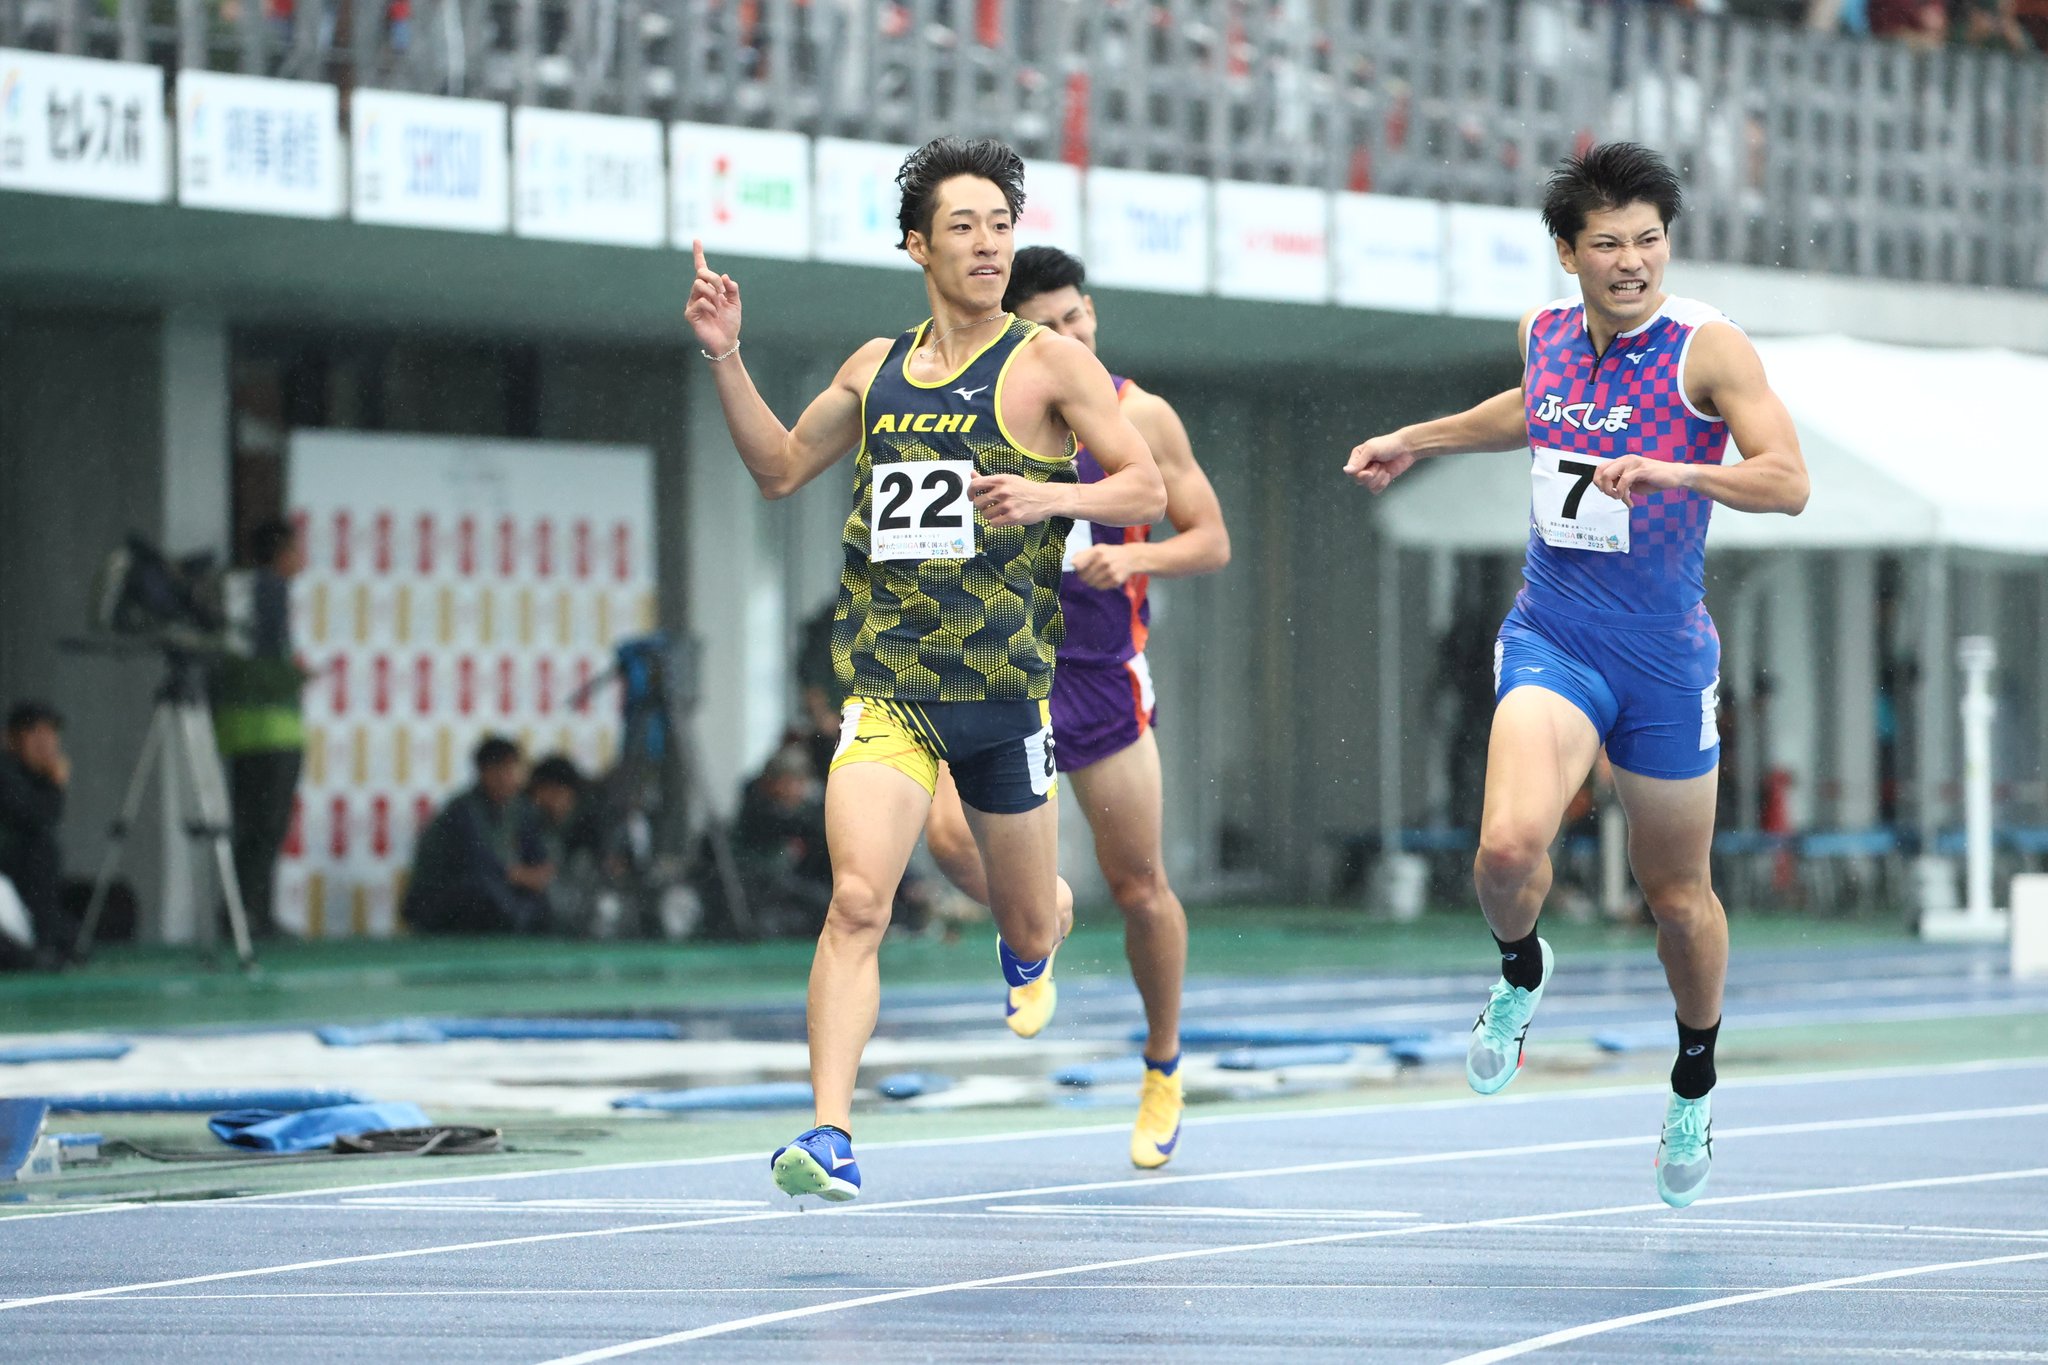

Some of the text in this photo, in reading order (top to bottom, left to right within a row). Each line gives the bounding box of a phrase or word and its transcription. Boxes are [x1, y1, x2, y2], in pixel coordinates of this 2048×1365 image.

[46, 87, 142, 165] セレスポ
[872, 413, 978, 435] AICHI
[1535, 394, 1633, 433] ふくしま
[877, 469, 964, 531] 22
[1558, 459, 1598, 520] 7
[1587, 541, 1604, 549] 2025
